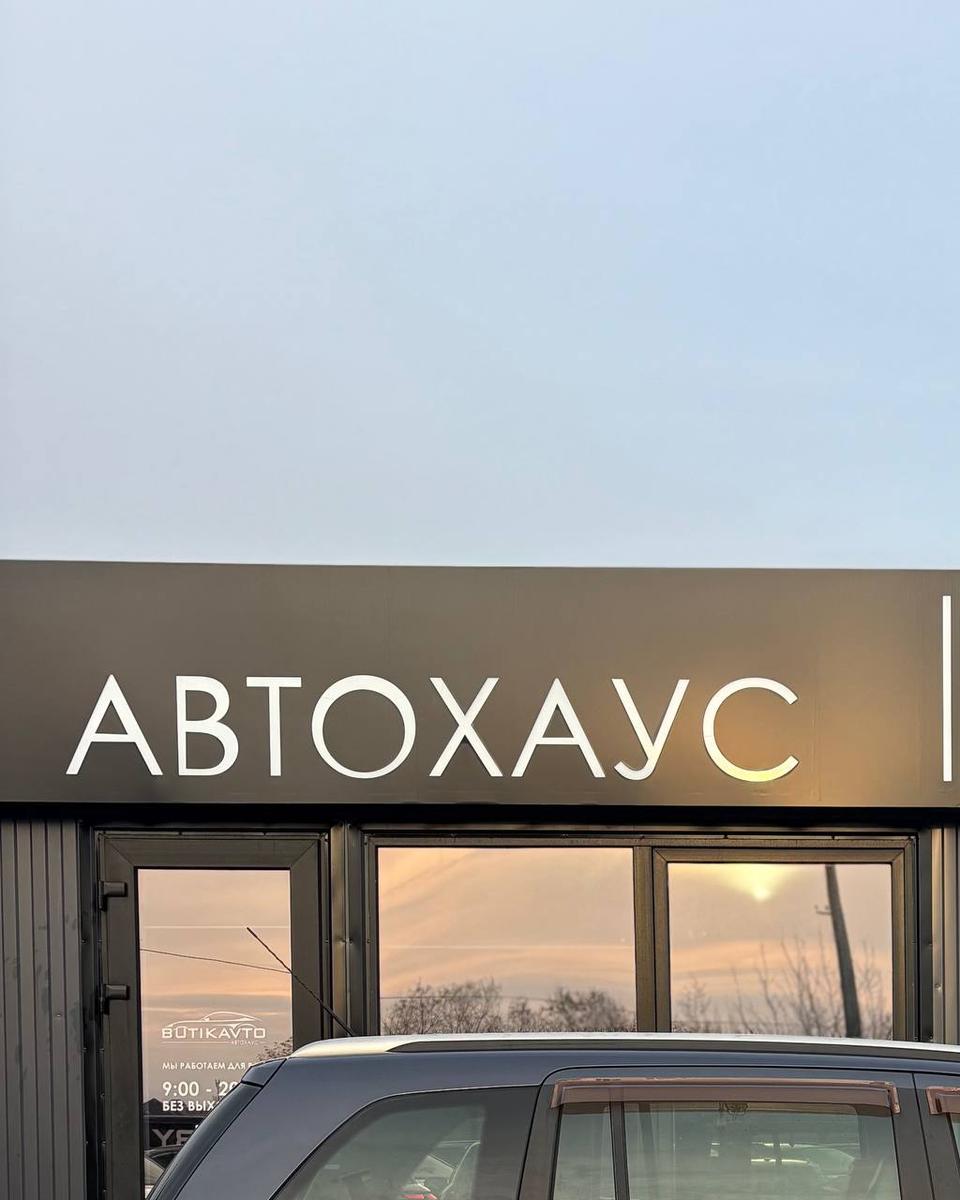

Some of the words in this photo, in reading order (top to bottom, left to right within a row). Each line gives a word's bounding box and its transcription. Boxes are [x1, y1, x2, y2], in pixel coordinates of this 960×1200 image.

[66, 674, 800, 783] АВТОХАУС
[161, 1027, 266, 1039] BUTIKAVTO
[162, 1062, 178, 1070] МЫ
[180, 1062, 226, 1070] РАБОТАЕМ
[228, 1062, 246, 1071] ДЛЯ
[162, 1081, 200, 1097] 9:00
[162, 1101, 184, 1112] БЕЗ
